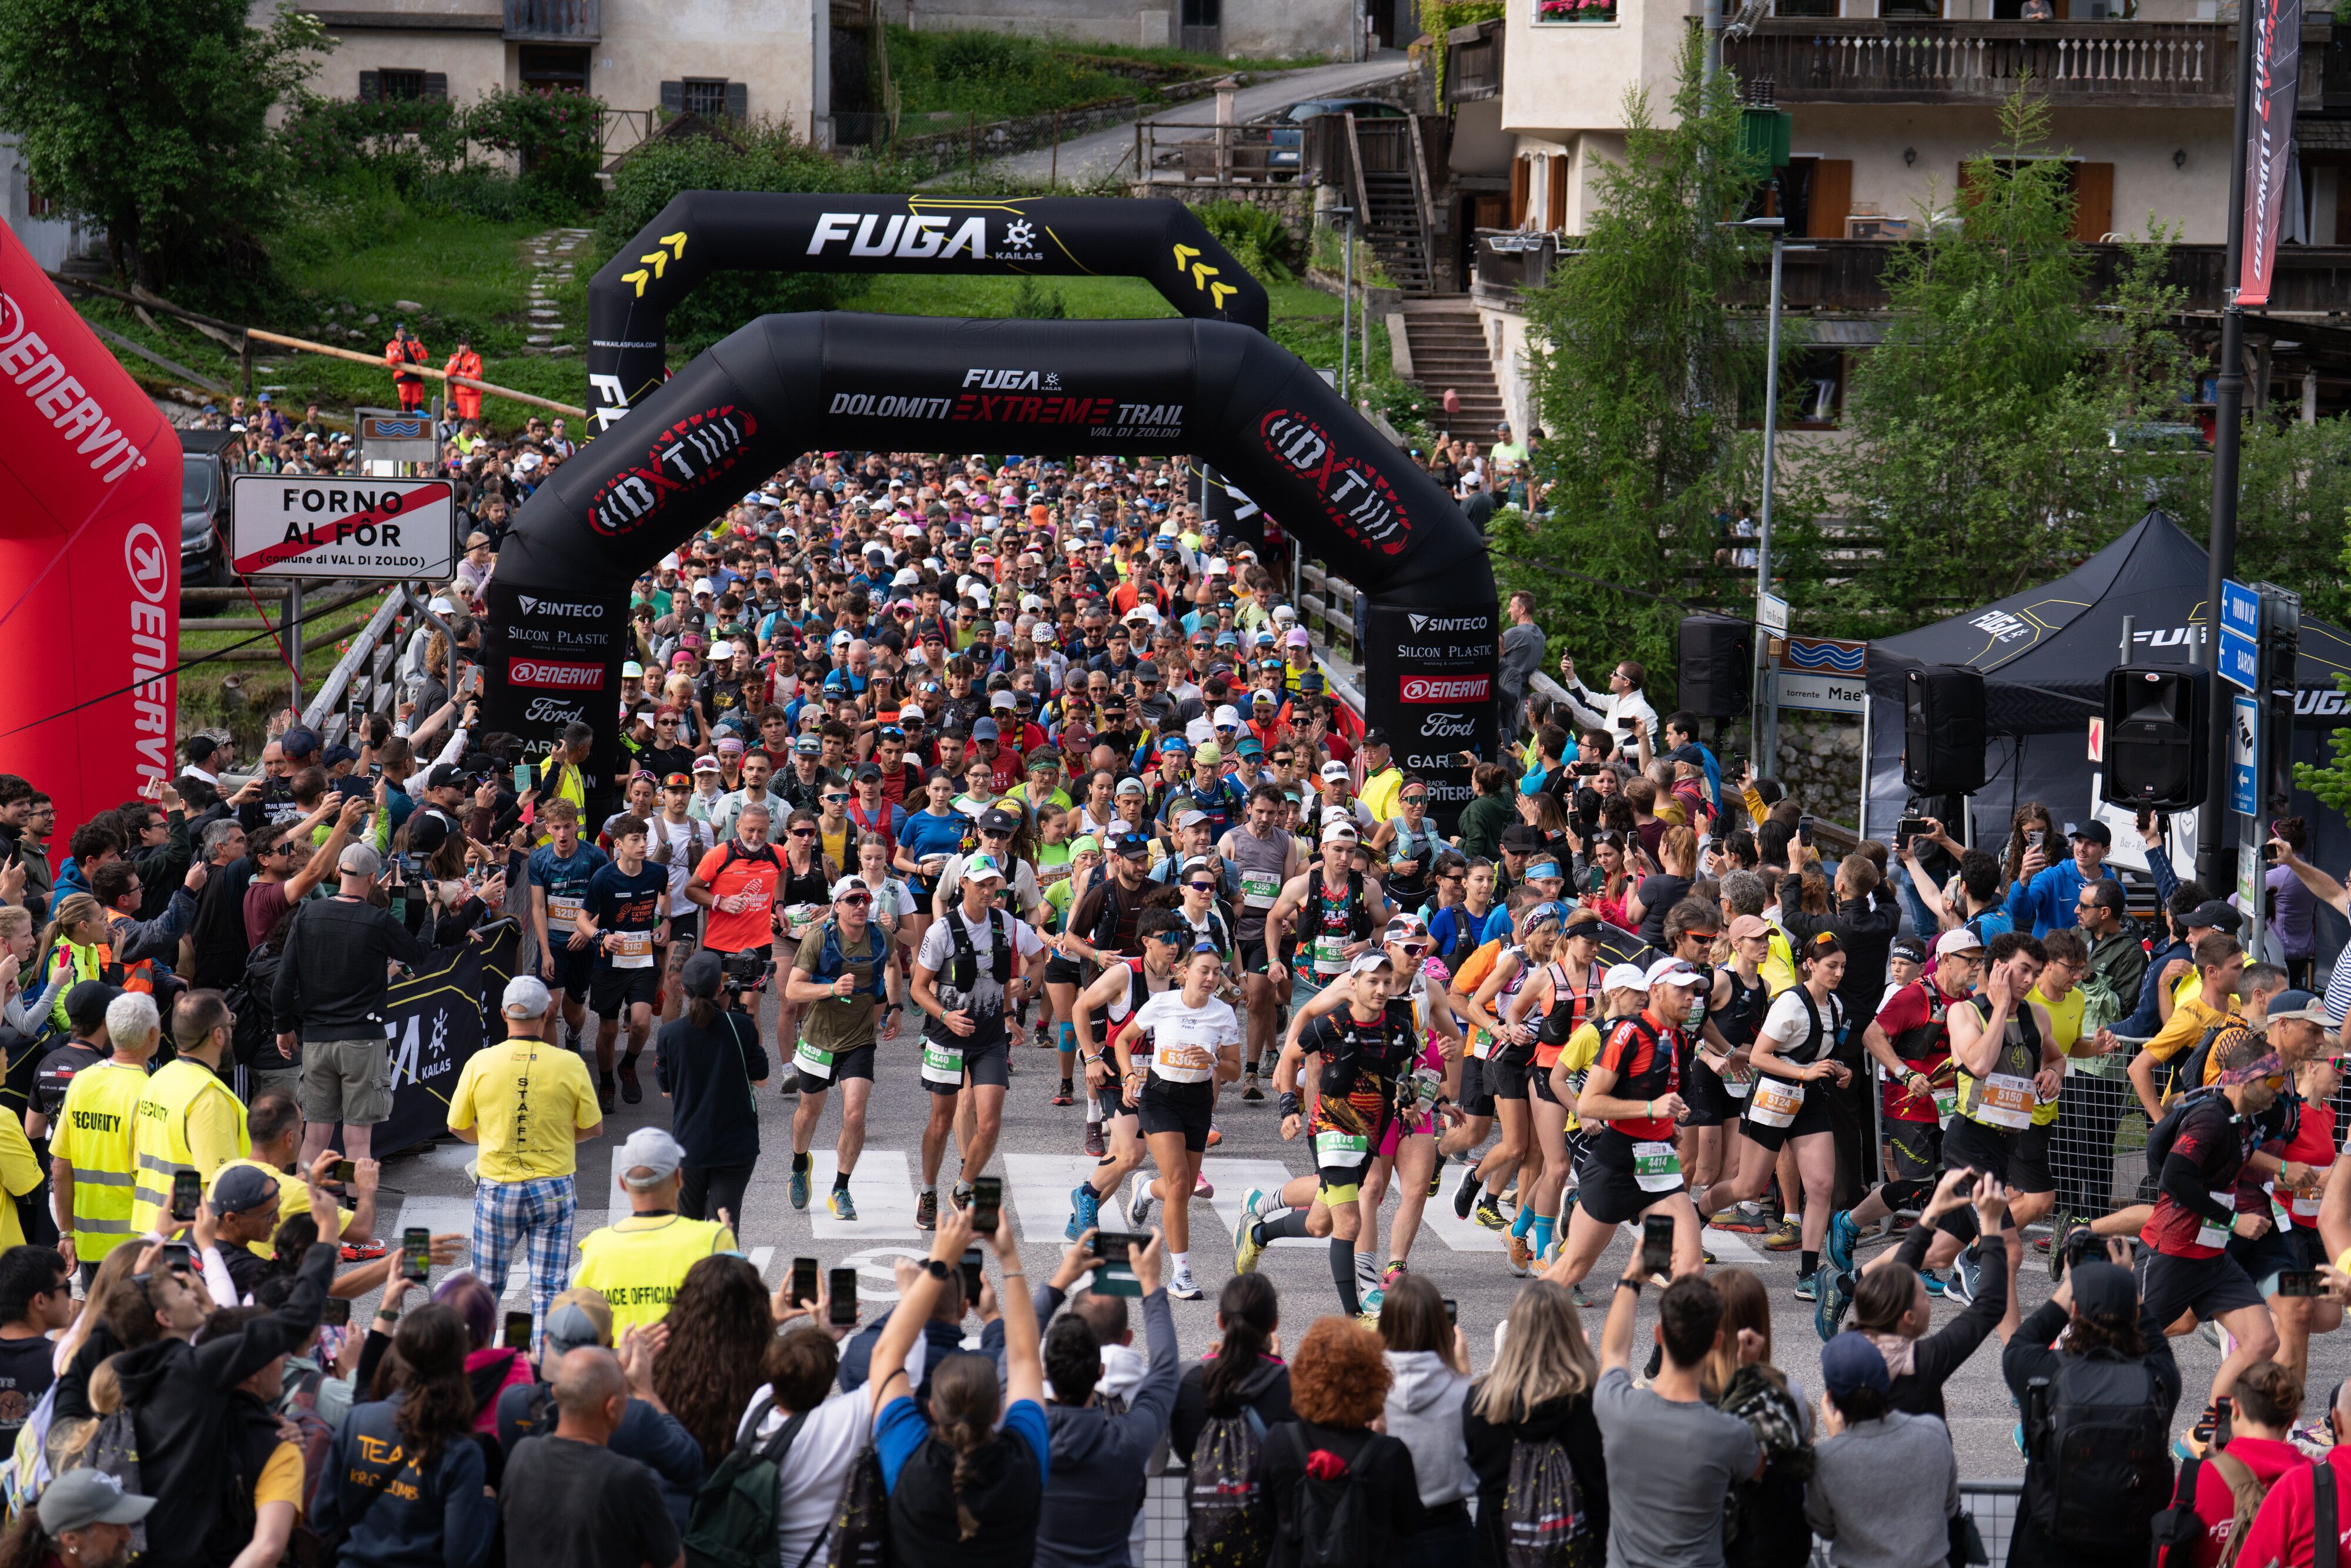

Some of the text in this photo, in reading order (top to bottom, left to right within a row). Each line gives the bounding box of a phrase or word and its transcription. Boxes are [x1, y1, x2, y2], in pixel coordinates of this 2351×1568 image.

[2255, 18, 2265, 116] FUGA
[2255, 128, 2270, 281] DOLOMITI
[806, 213, 986, 259] FUGA
[995, 251, 1044, 260] KAILAS
[592, 339, 658, 349] WWW.KAILASFUGA.COM
[962, 368, 1039, 390] FUGA
[0, 331, 147, 484] ENERVIT
[829, 393, 1183, 425] DOLOMITI EXTREME TRAIL
[1090, 426, 1181, 438] VAL DI ZOLDO
[283, 488, 403, 514] FORNO
[282, 517, 401, 547] AL FÔR
[259, 554, 426, 568] (comune di VAL DI ZOLDO)
[537, 601, 604, 618] SINTECO
[2233, 596, 2245, 622] FORNO
[2245, 602, 2249, 624] DI
[1428, 617, 1488, 631] SINTECO
[1968, 610, 2024, 637] FUGA
[508, 625, 608, 645] SILCON PLASTIC
[1398, 645, 1492, 658] SILCON PLASTIC
[2237, 649, 2255, 677] BARON
[534, 666, 602, 685] ENERVIT
[1428, 679, 1488, 698] ENERVIT
[1787, 689, 1820, 698] torrente
[525, 697, 584, 723] Ford
[1421, 712, 1475, 736] Ford
[279, 802, 297, 810] RUNNIN
[2120, 836, 2131, 847] Bar
[1252, 882, 1271, 890] 4355
[554, 907, 580, 919] 5284
[624, 943, 642, 951] 5183
[1327, 948, 1342, 957] 453
[802, 1043, 822, 1056] 4439
[929, 1053, 949, 1064] 4440
[2011, 1046, 2026, 1069] 4
[422, 1058, 451, 1080] KAILAS
[1768, 1094, 1791, 1108] 5124
[1998, 1090, 2023, 1103] 5150
[72, 1110, 121, 1133] SECURITY
[1328, 1135, 1354, 1144] 4178
[1891, 1138, 1929, 1165] DYNAFIT
[1648, 1157, 1667, 1168] 4414
[631, 1285, 677, 1304] OFFICIA
[1824, 1308, 1833, 1322] TEX
